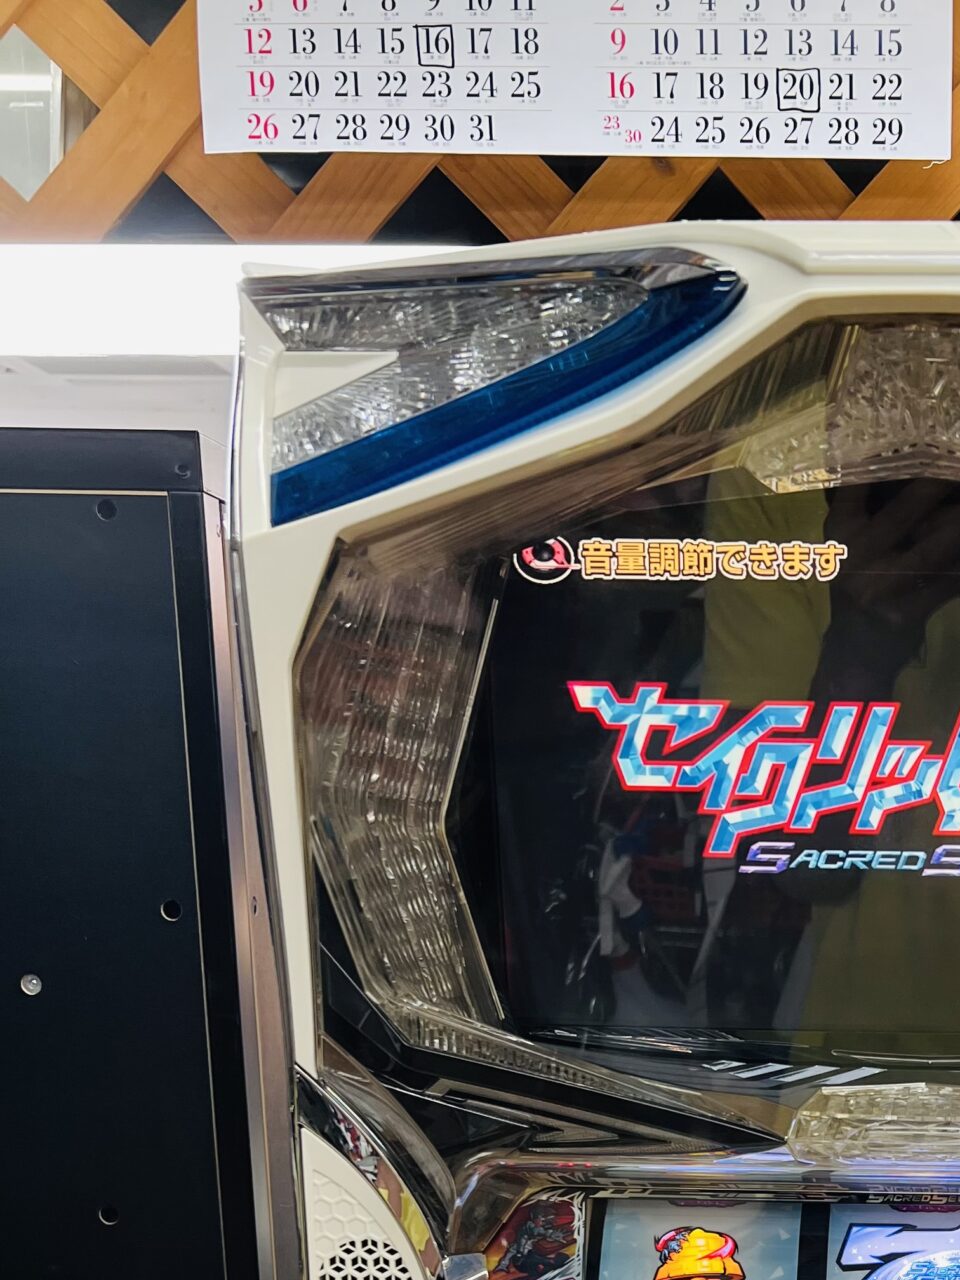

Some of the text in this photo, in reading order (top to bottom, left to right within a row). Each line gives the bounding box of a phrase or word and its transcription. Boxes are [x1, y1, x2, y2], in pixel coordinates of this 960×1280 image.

[243, 27, 540, 55] 12 13 14 15 16 17 18
[609, 28, 903, 57] 9 10 11 12 13 14 15
[248, 70, 541, 99] 19 20 21 22 23 24 25
[608, 71, 903, 101] 16 17 18 19 20 21 22
[246, 113, 494, 142] 26 27 28 29 30 31
[602, 115, 903, 146] 23 30 24 25 26 27 28 29
[578, 538, 848, 583] 音量調節できます
[738, 841, 923, 875] SACRED
